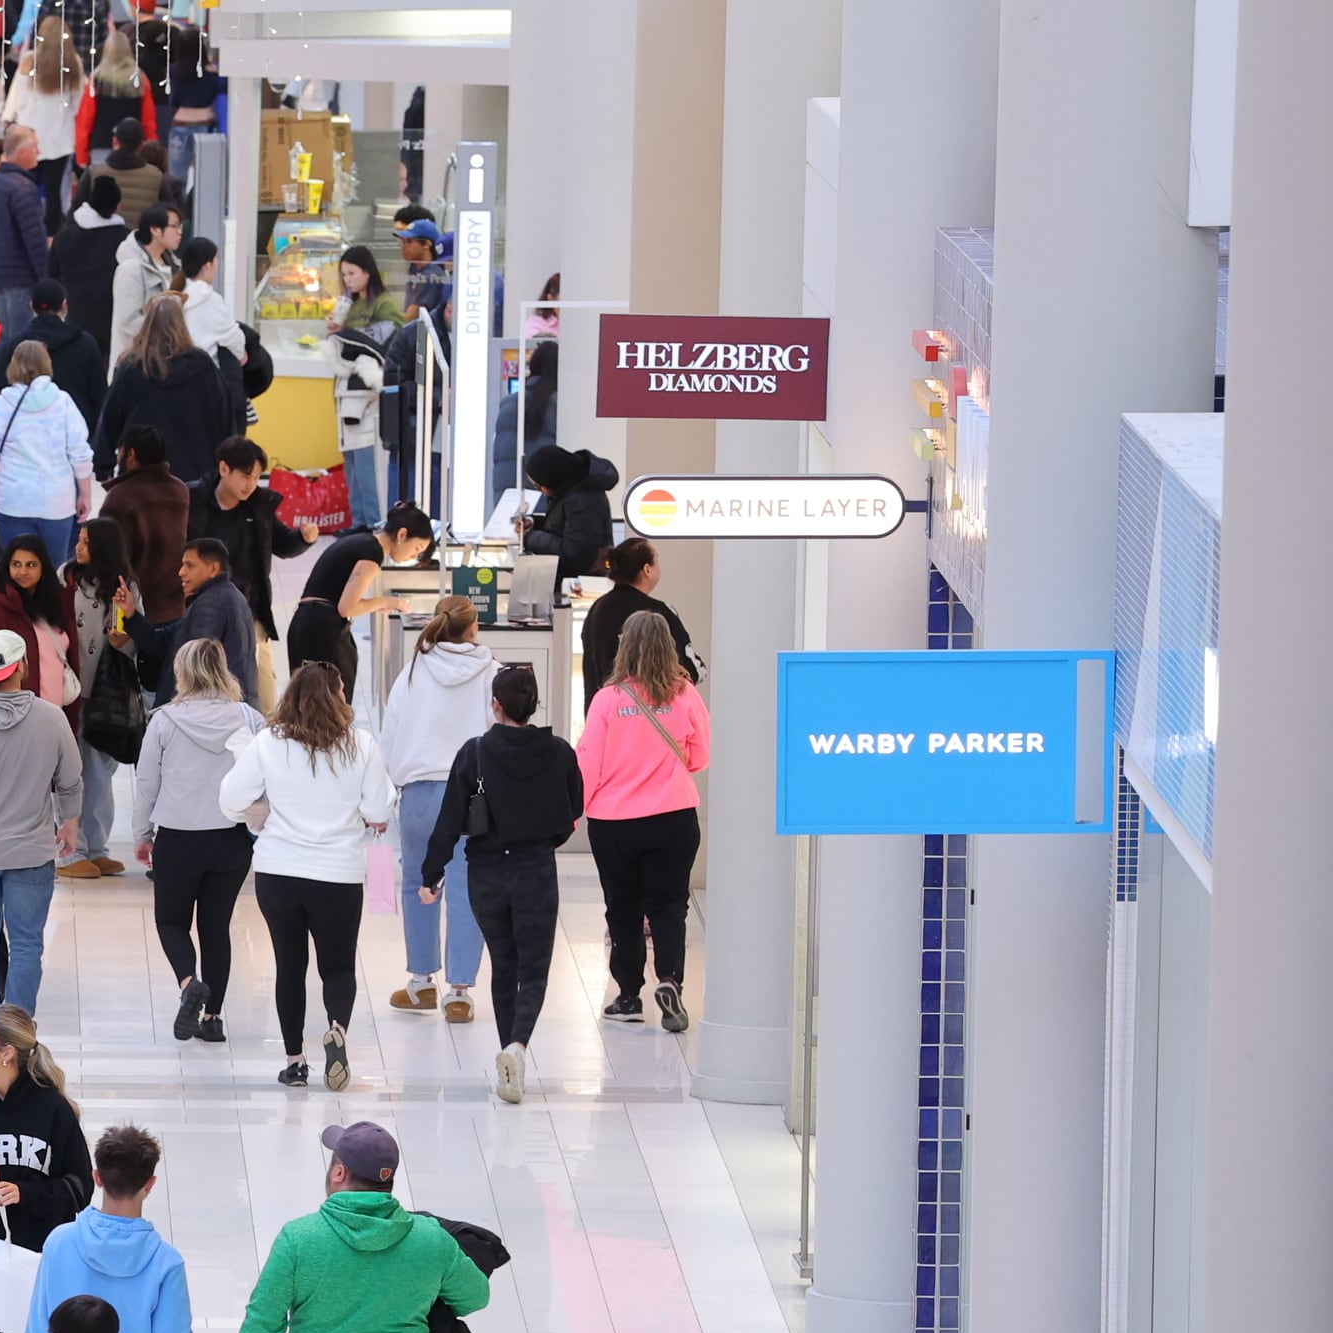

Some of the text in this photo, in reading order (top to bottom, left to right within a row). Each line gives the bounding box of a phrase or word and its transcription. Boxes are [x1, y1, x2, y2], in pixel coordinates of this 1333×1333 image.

[465, 217, 483, 334] DIRECTORY
[616, 341, 810, 374] HELZBERG
[648, 372, 777, 395] DIAMONDS
[685, 497, 888, 519] MARINE LAYER
[808, 733, 1045, 755] WARBY PARKER
